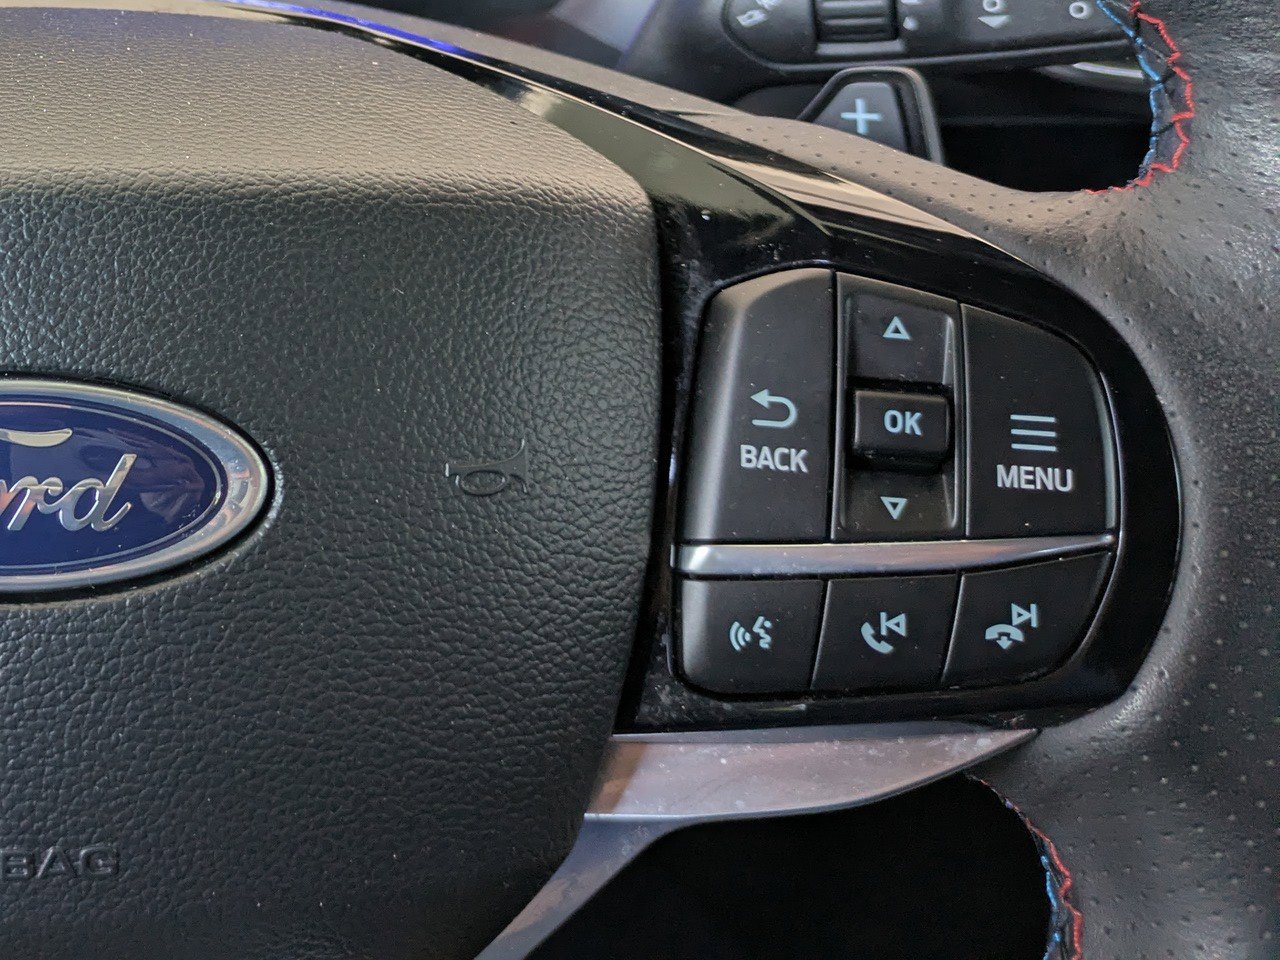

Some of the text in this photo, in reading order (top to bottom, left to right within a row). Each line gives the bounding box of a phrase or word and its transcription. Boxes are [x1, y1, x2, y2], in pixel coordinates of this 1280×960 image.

[883, 410, 923, 436] OK
[740, 444, 809, 474] BACK
[996, 464, 1074, 493] MENU
